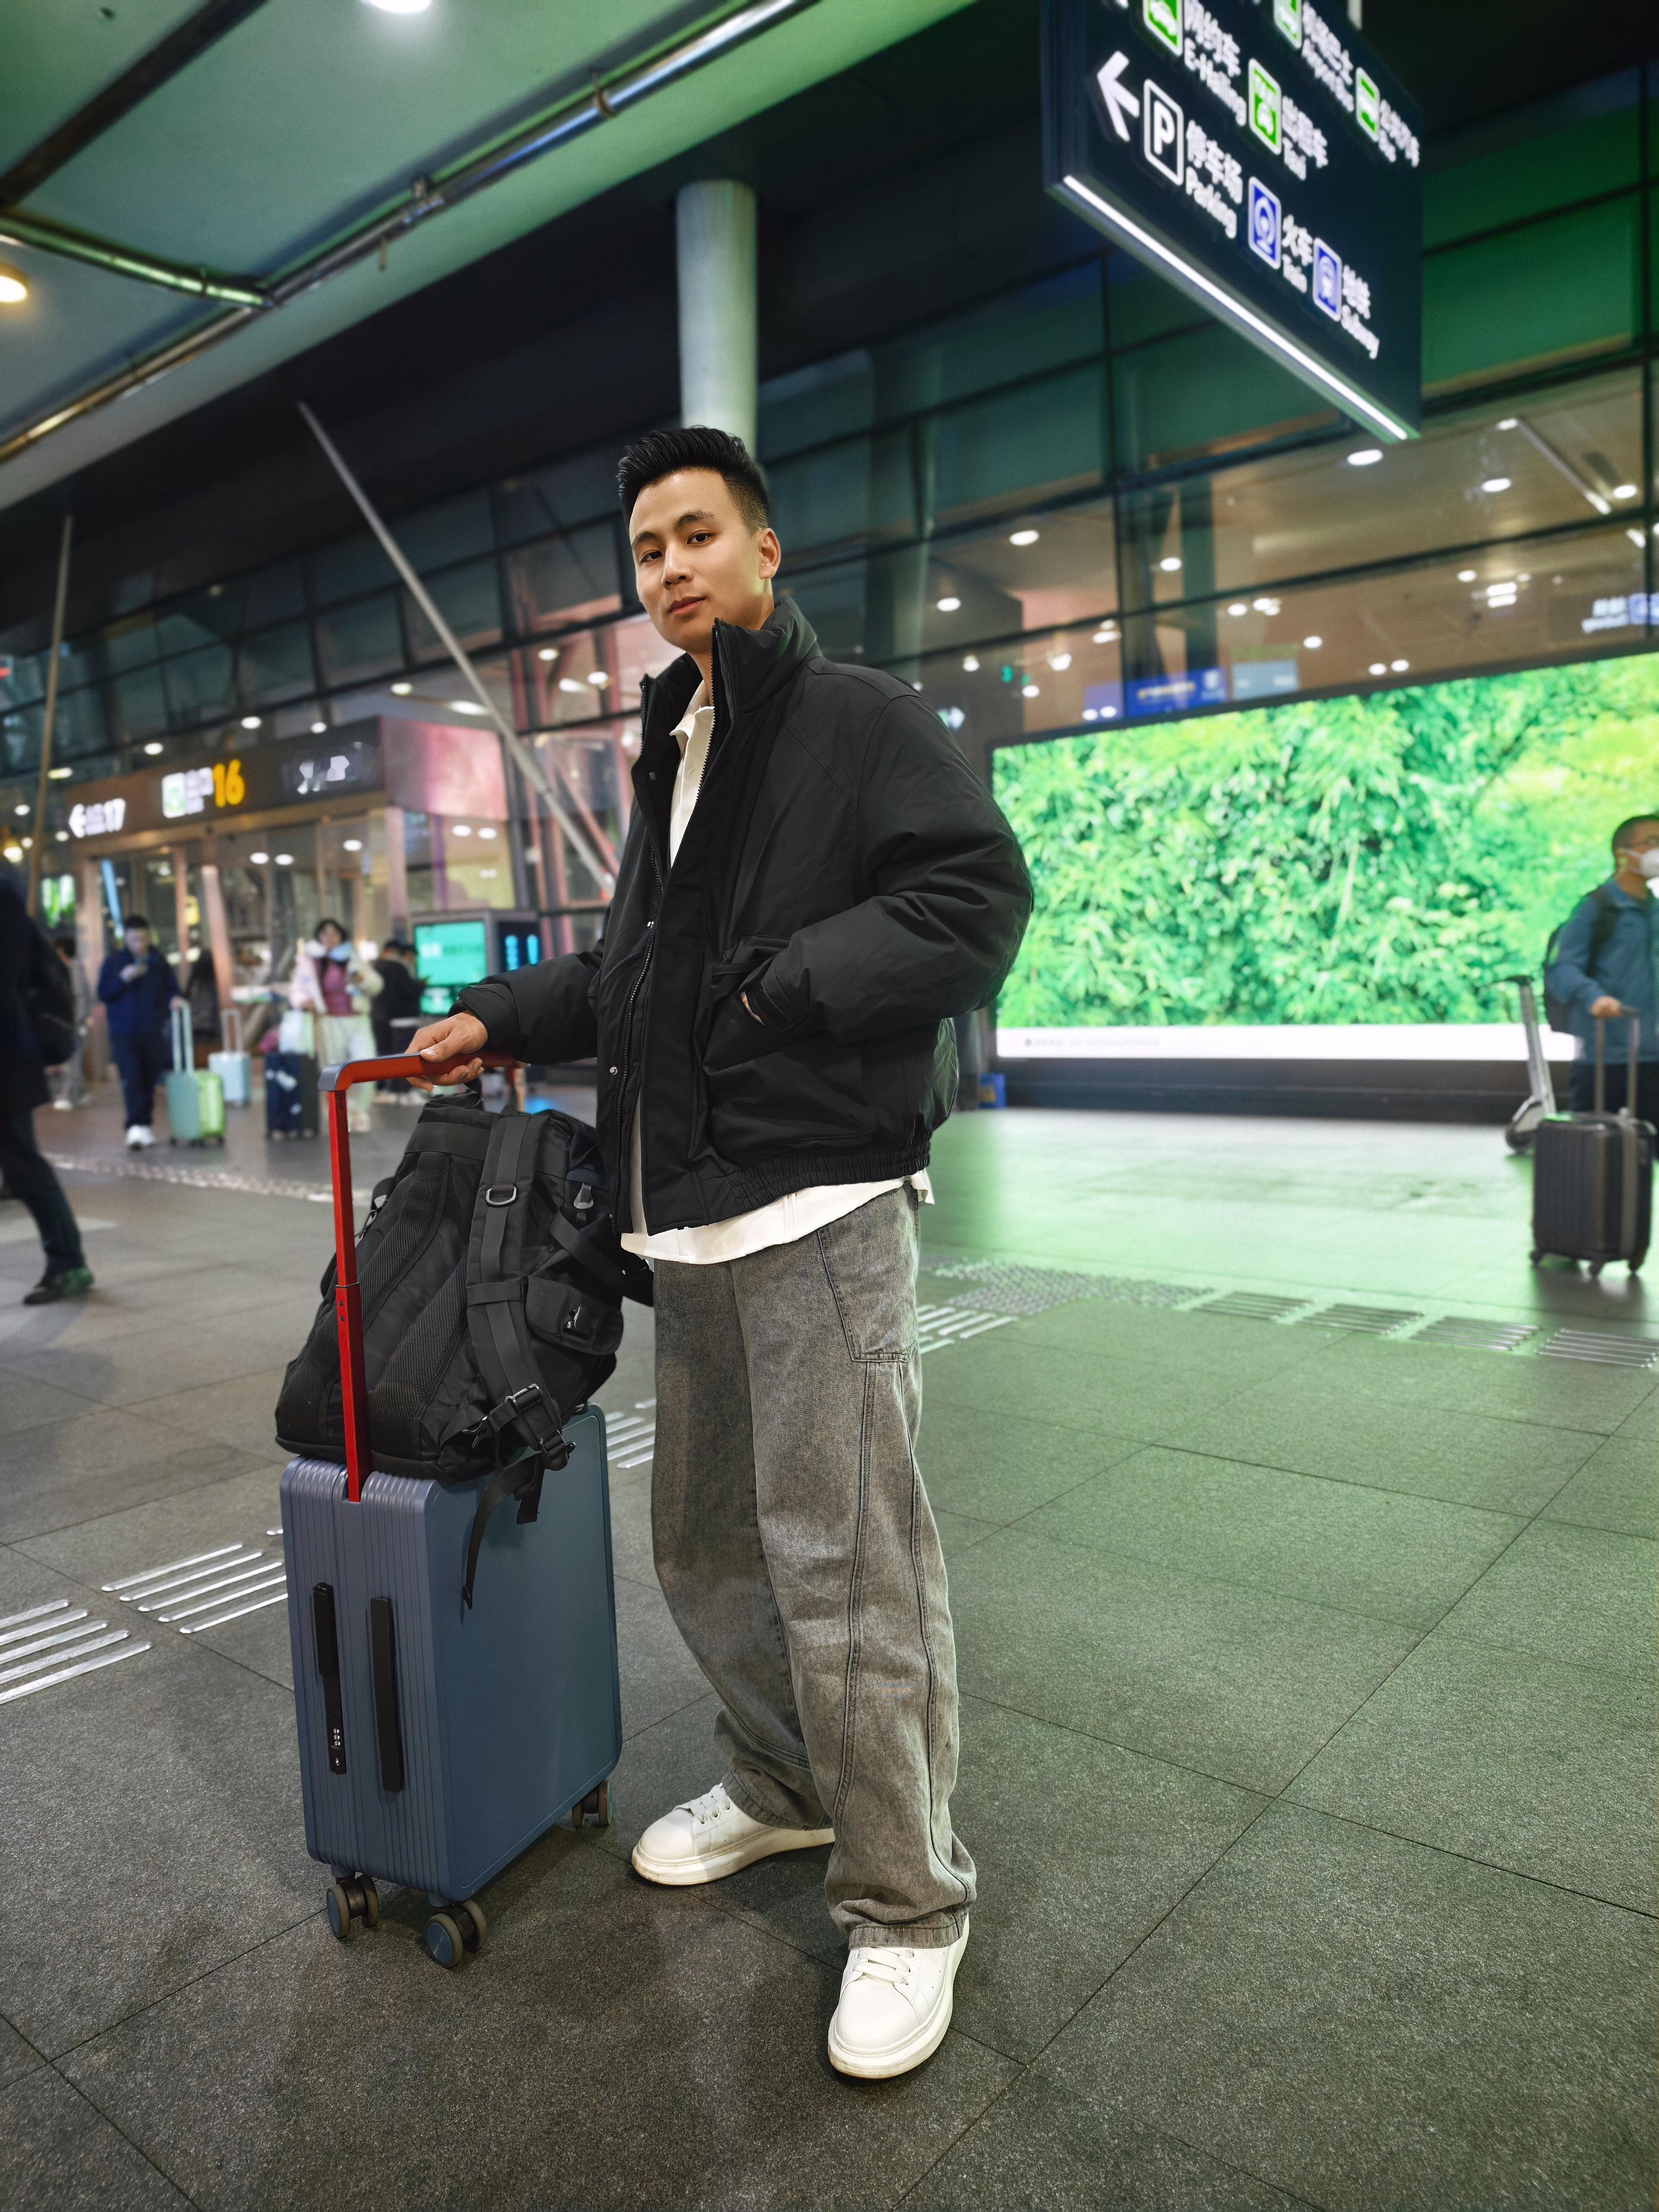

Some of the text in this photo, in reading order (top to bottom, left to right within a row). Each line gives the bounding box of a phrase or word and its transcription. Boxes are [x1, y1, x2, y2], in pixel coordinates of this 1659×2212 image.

[1154, 100, 1175, 154] P
[1186, 120, 1243, 204] 停车场
[1186, 166, 1237, 239] Parking
[212, 758, 245, 808] 16
[104, 798, 126, 832] 17
